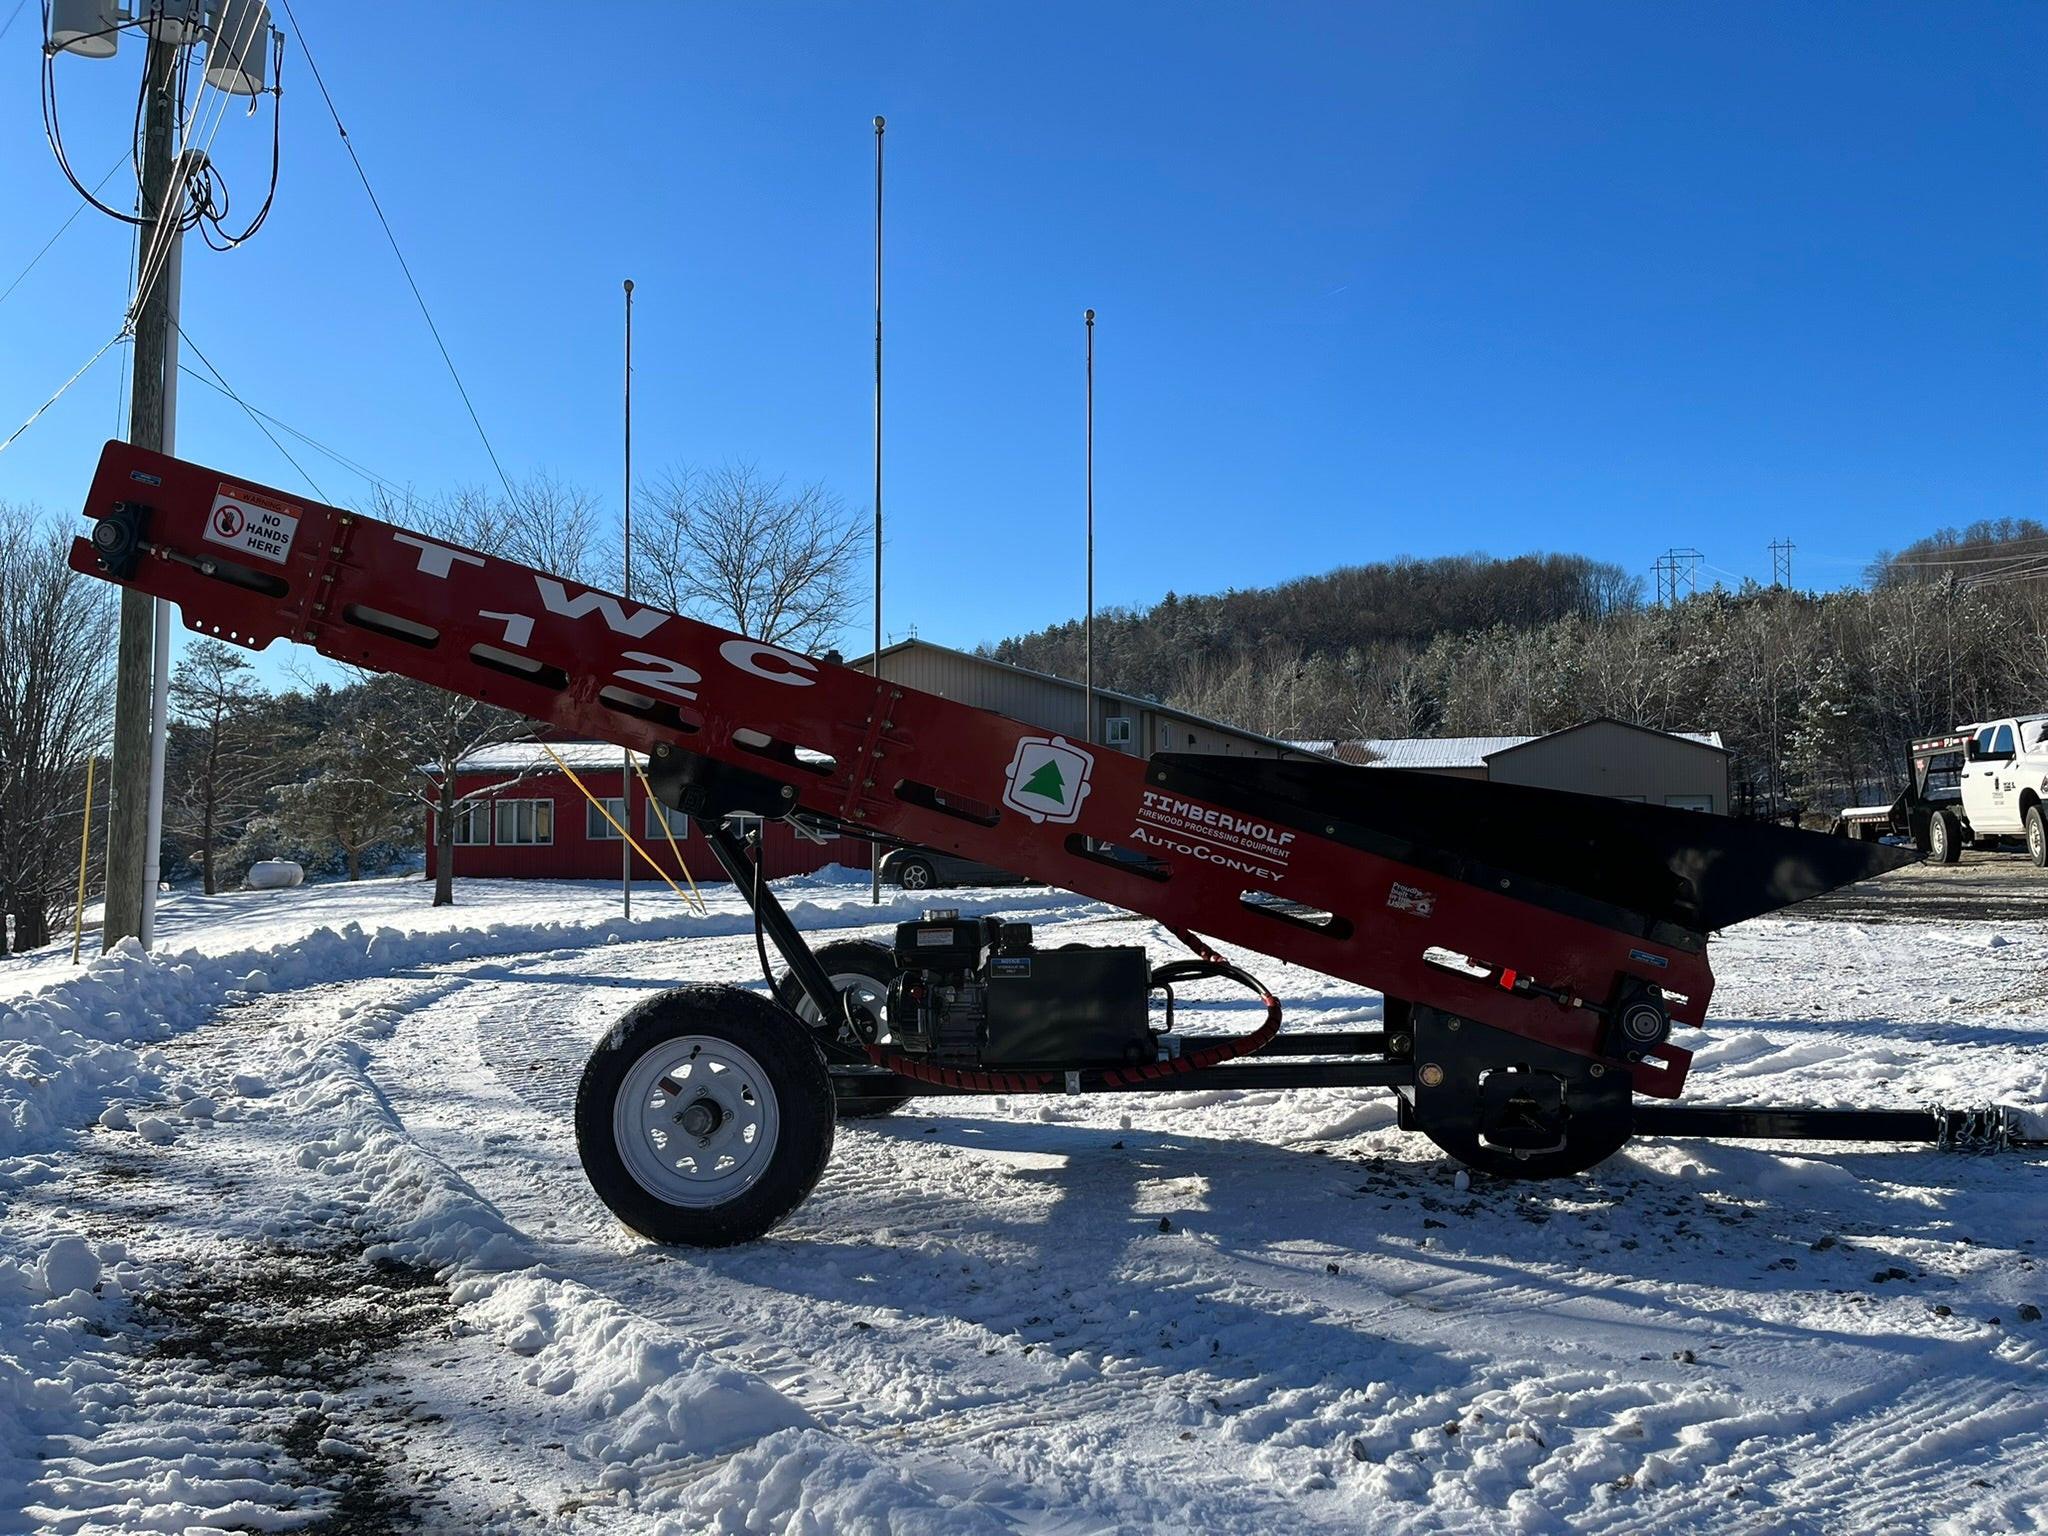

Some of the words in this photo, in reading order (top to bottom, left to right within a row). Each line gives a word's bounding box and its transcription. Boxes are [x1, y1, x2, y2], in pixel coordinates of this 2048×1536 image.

[243, 495, 281, 511] WARNING
[262, 513, 281, 527] NO
[246, 522, 290, 544] HANDS
[247, 537, 282, 556] HERE
[1143, 791, 1296, 846] TIMBERWOLF
[1138, 808, 1184, 827] FIREWOOD
[1184, 821, 1240, 845] PROCESSING
[1240, 837, 1291, 859] EQUIPMENT
